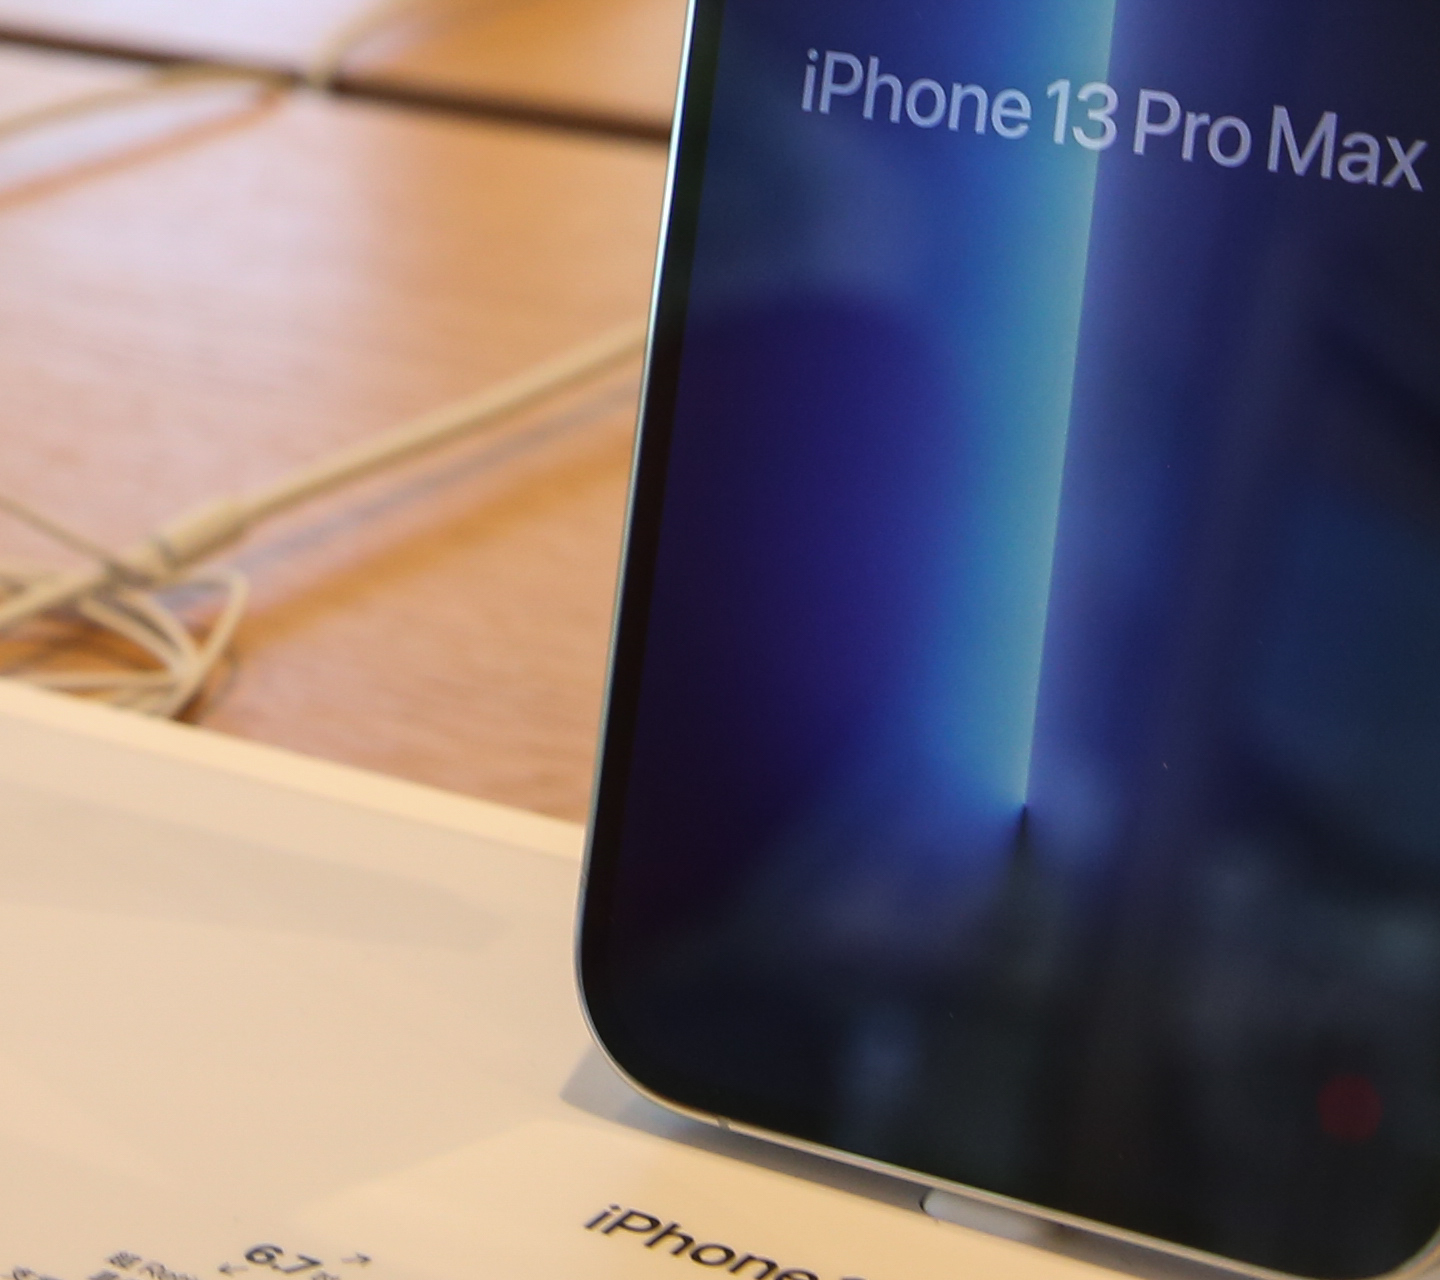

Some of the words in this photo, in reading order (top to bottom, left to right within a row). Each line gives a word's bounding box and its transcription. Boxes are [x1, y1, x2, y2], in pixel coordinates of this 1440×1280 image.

[801, 48, 1032, 139] iPhone
[1046, 77, 1120, 151] 13
[1133, 88, 1252, 168] Pro
[1267, 104, 1428, 192] Max
[244, 1242, 324, 1274] 6.7
